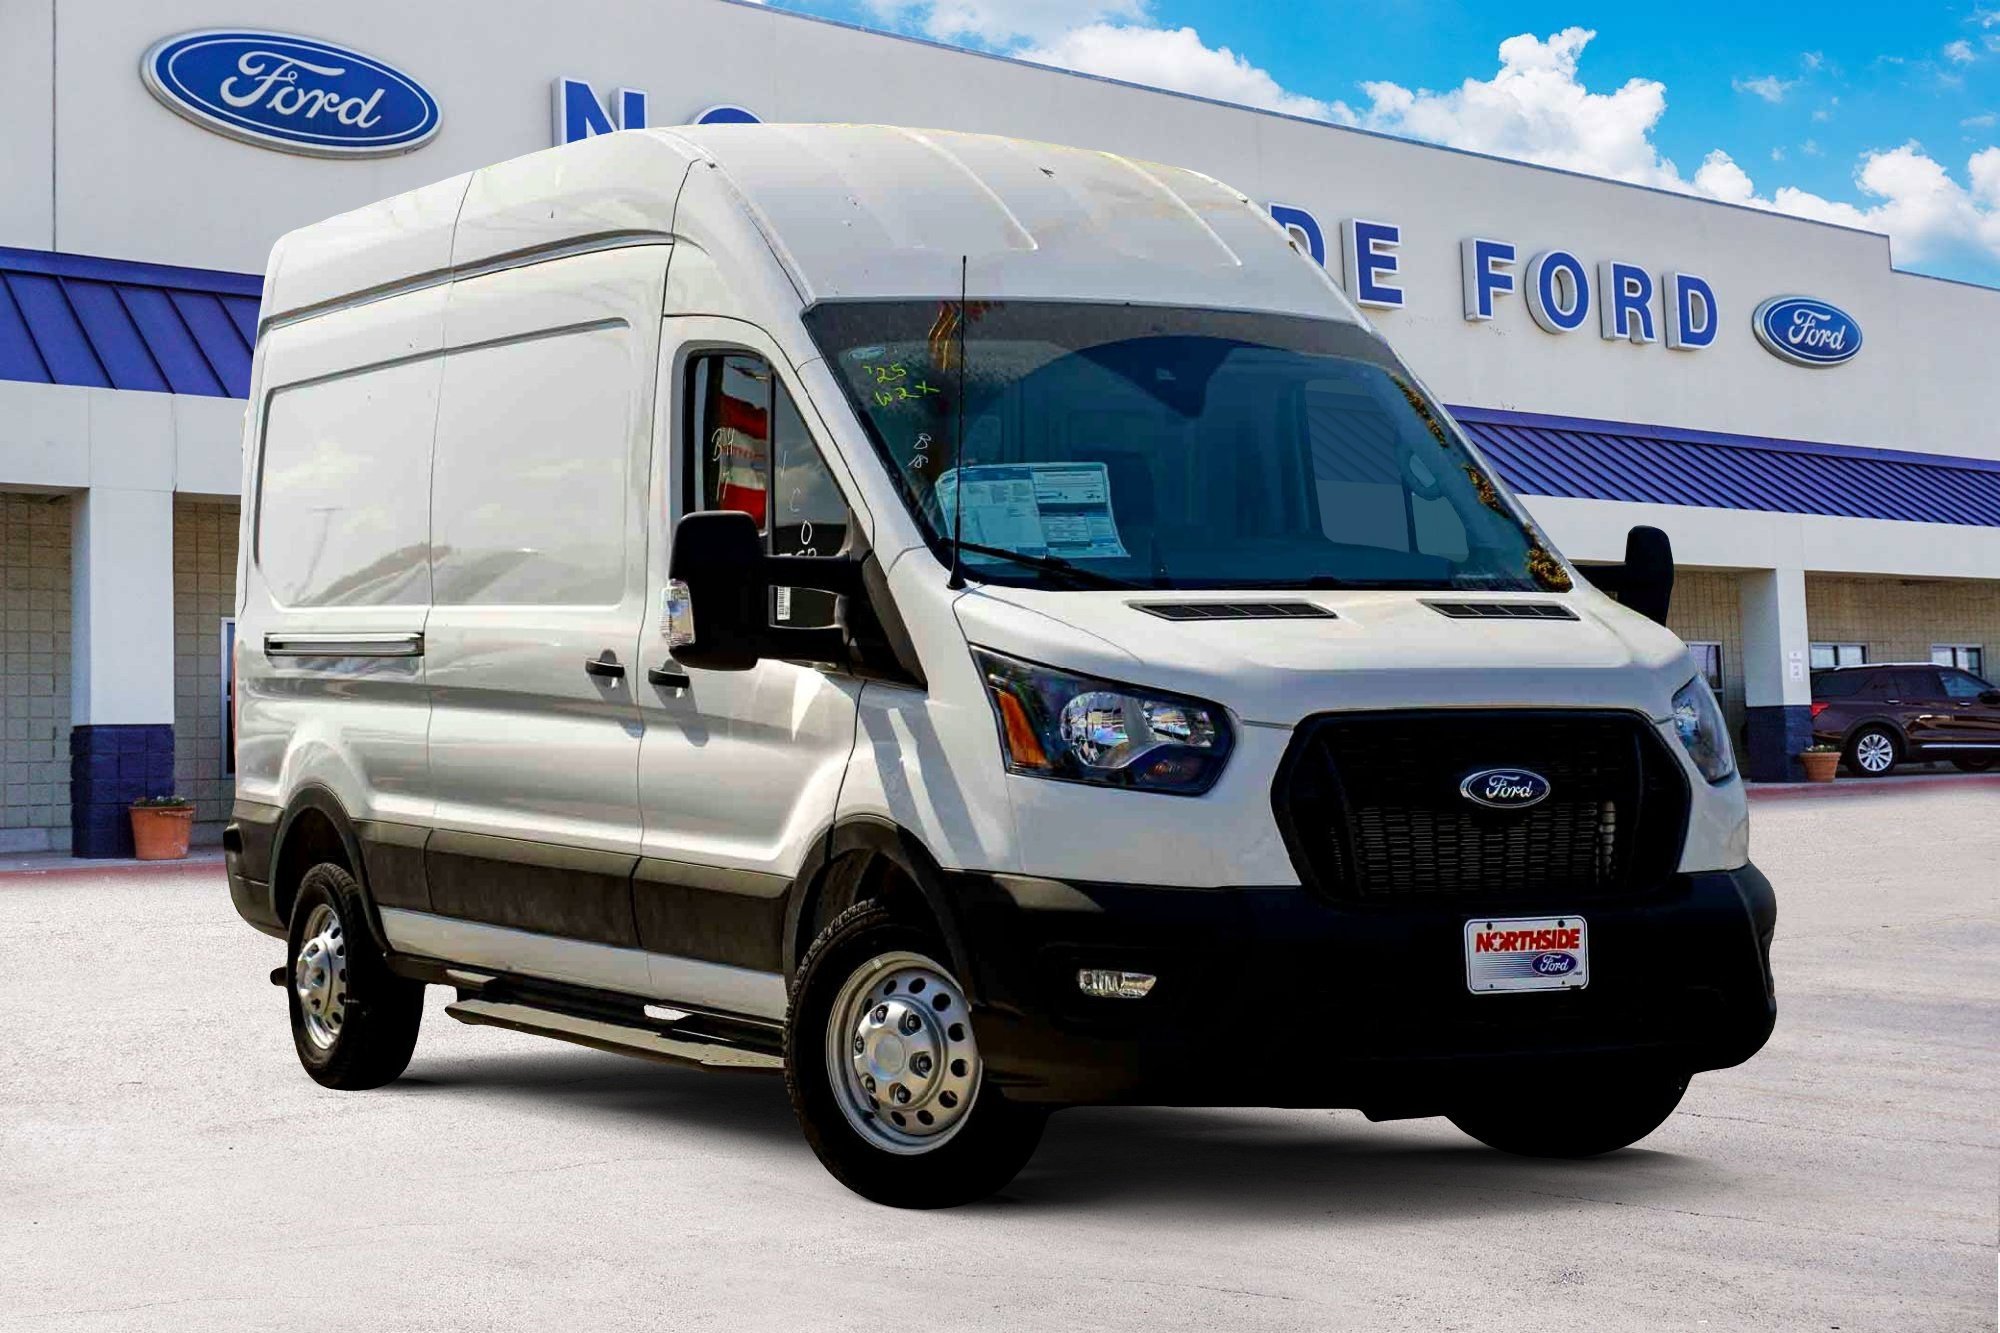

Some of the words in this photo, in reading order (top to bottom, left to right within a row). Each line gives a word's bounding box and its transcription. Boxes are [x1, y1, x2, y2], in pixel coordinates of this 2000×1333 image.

[219, 50, 387, 130] Ford
[1461, 236, 1720, 351] FORD
[1788, 308, 1846, 351] Ford
[1485, 774, 1534, 799] Ford
[1475, 928, 1581, 953] NORTHSIDE
[1540, 954, 1570, 972] Ford
